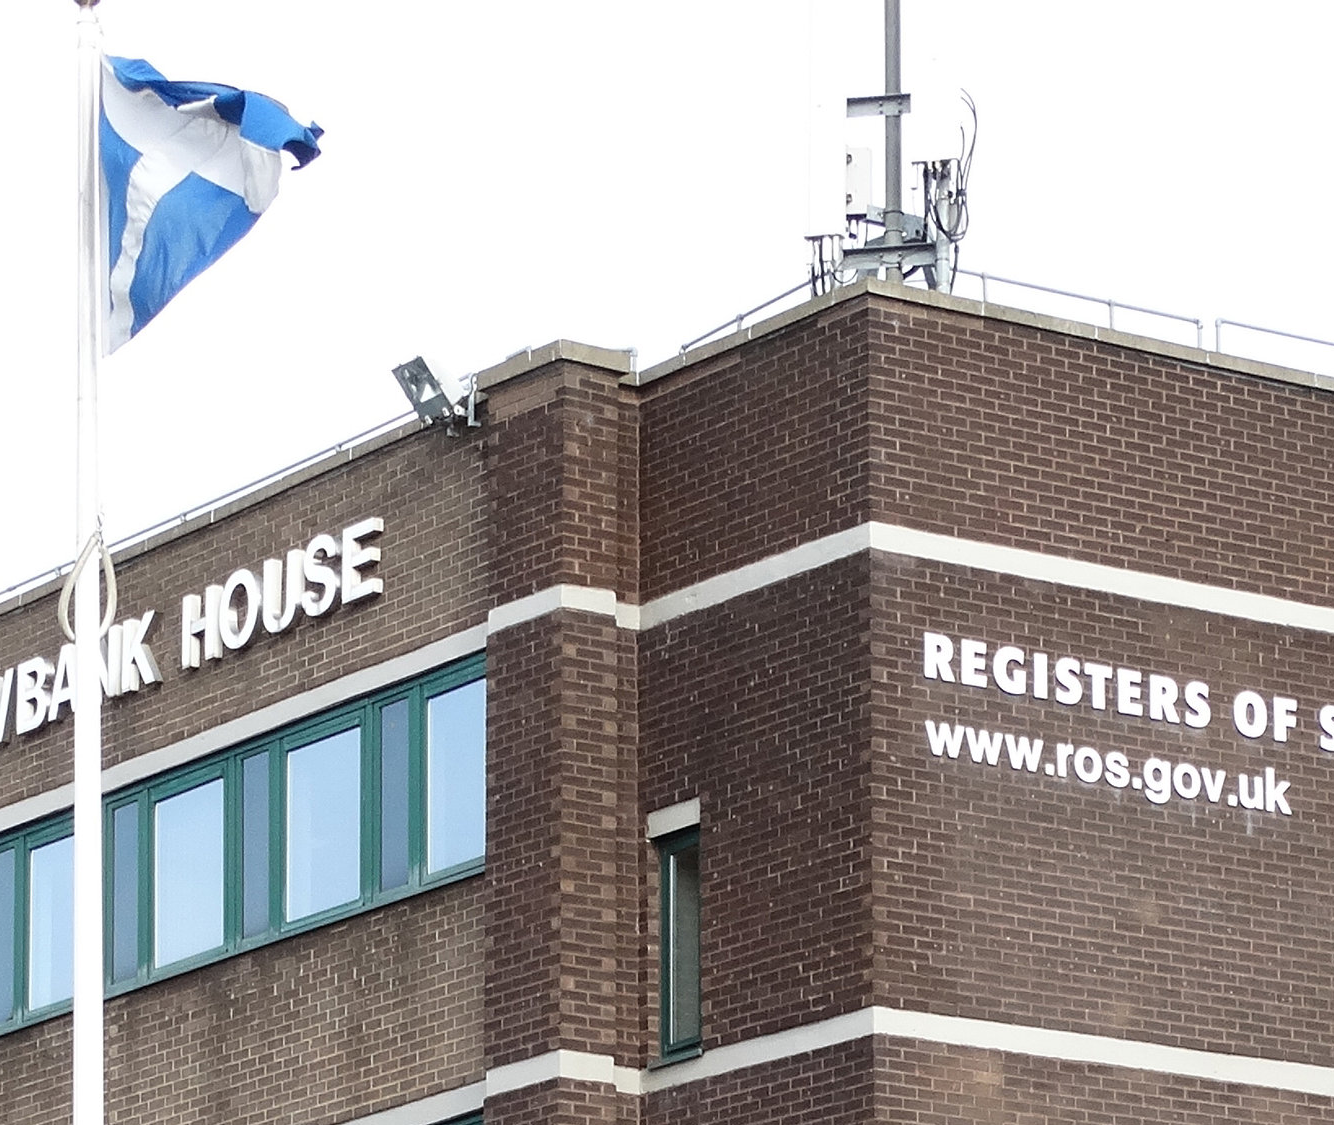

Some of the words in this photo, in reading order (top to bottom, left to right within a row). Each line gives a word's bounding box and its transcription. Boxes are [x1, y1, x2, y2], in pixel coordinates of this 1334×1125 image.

[182, 517, 385, 669] HOUSE
[923, 632, 1212, 728] REGISTERS
[1234, 690, 1298, 742] OF
[925, 720, 1292, 815] www.ros.gov.uk
